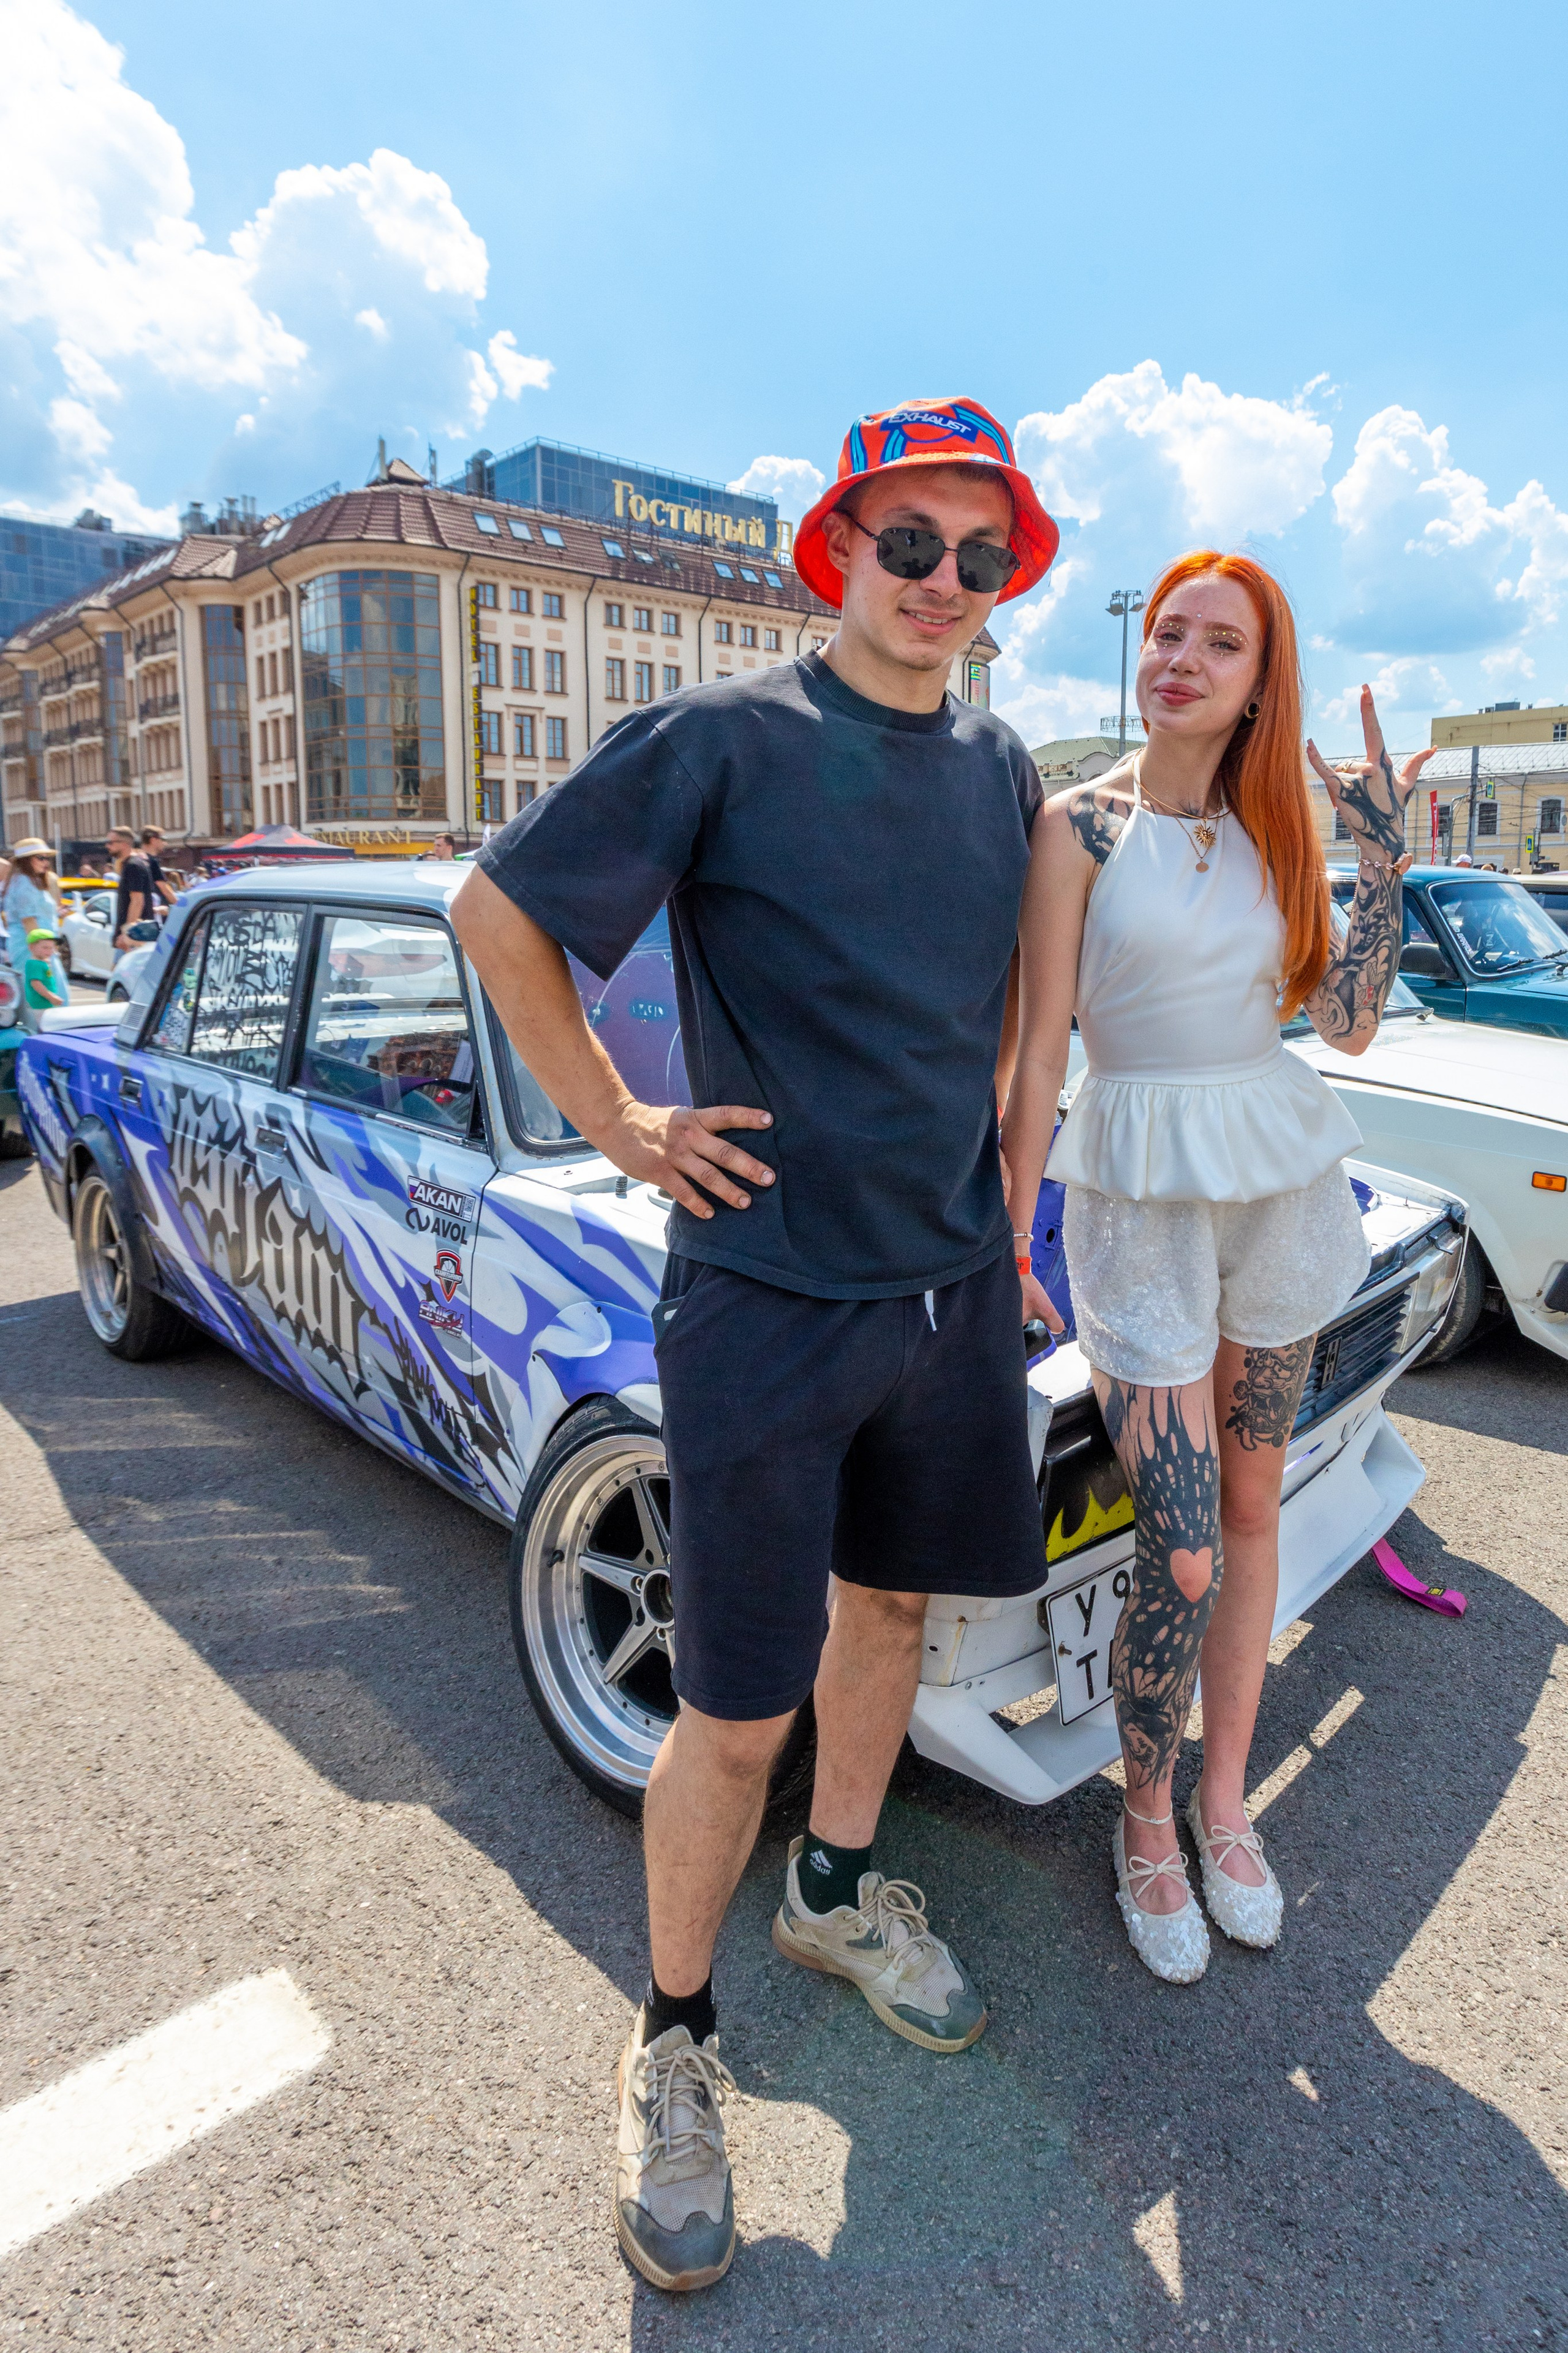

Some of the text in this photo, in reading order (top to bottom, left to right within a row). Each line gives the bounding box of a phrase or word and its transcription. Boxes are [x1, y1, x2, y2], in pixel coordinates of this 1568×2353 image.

[888, 412, 971, 433] EXHAUST
[612, 478, 766, 549] Гостиный
[469, 586, 478, 662] HOTEL
[413, 1184, 462, 1214] AKAN
[430, 1217, 468, 1245] AVOL
[809, 1858, 831, 1876] adidas
